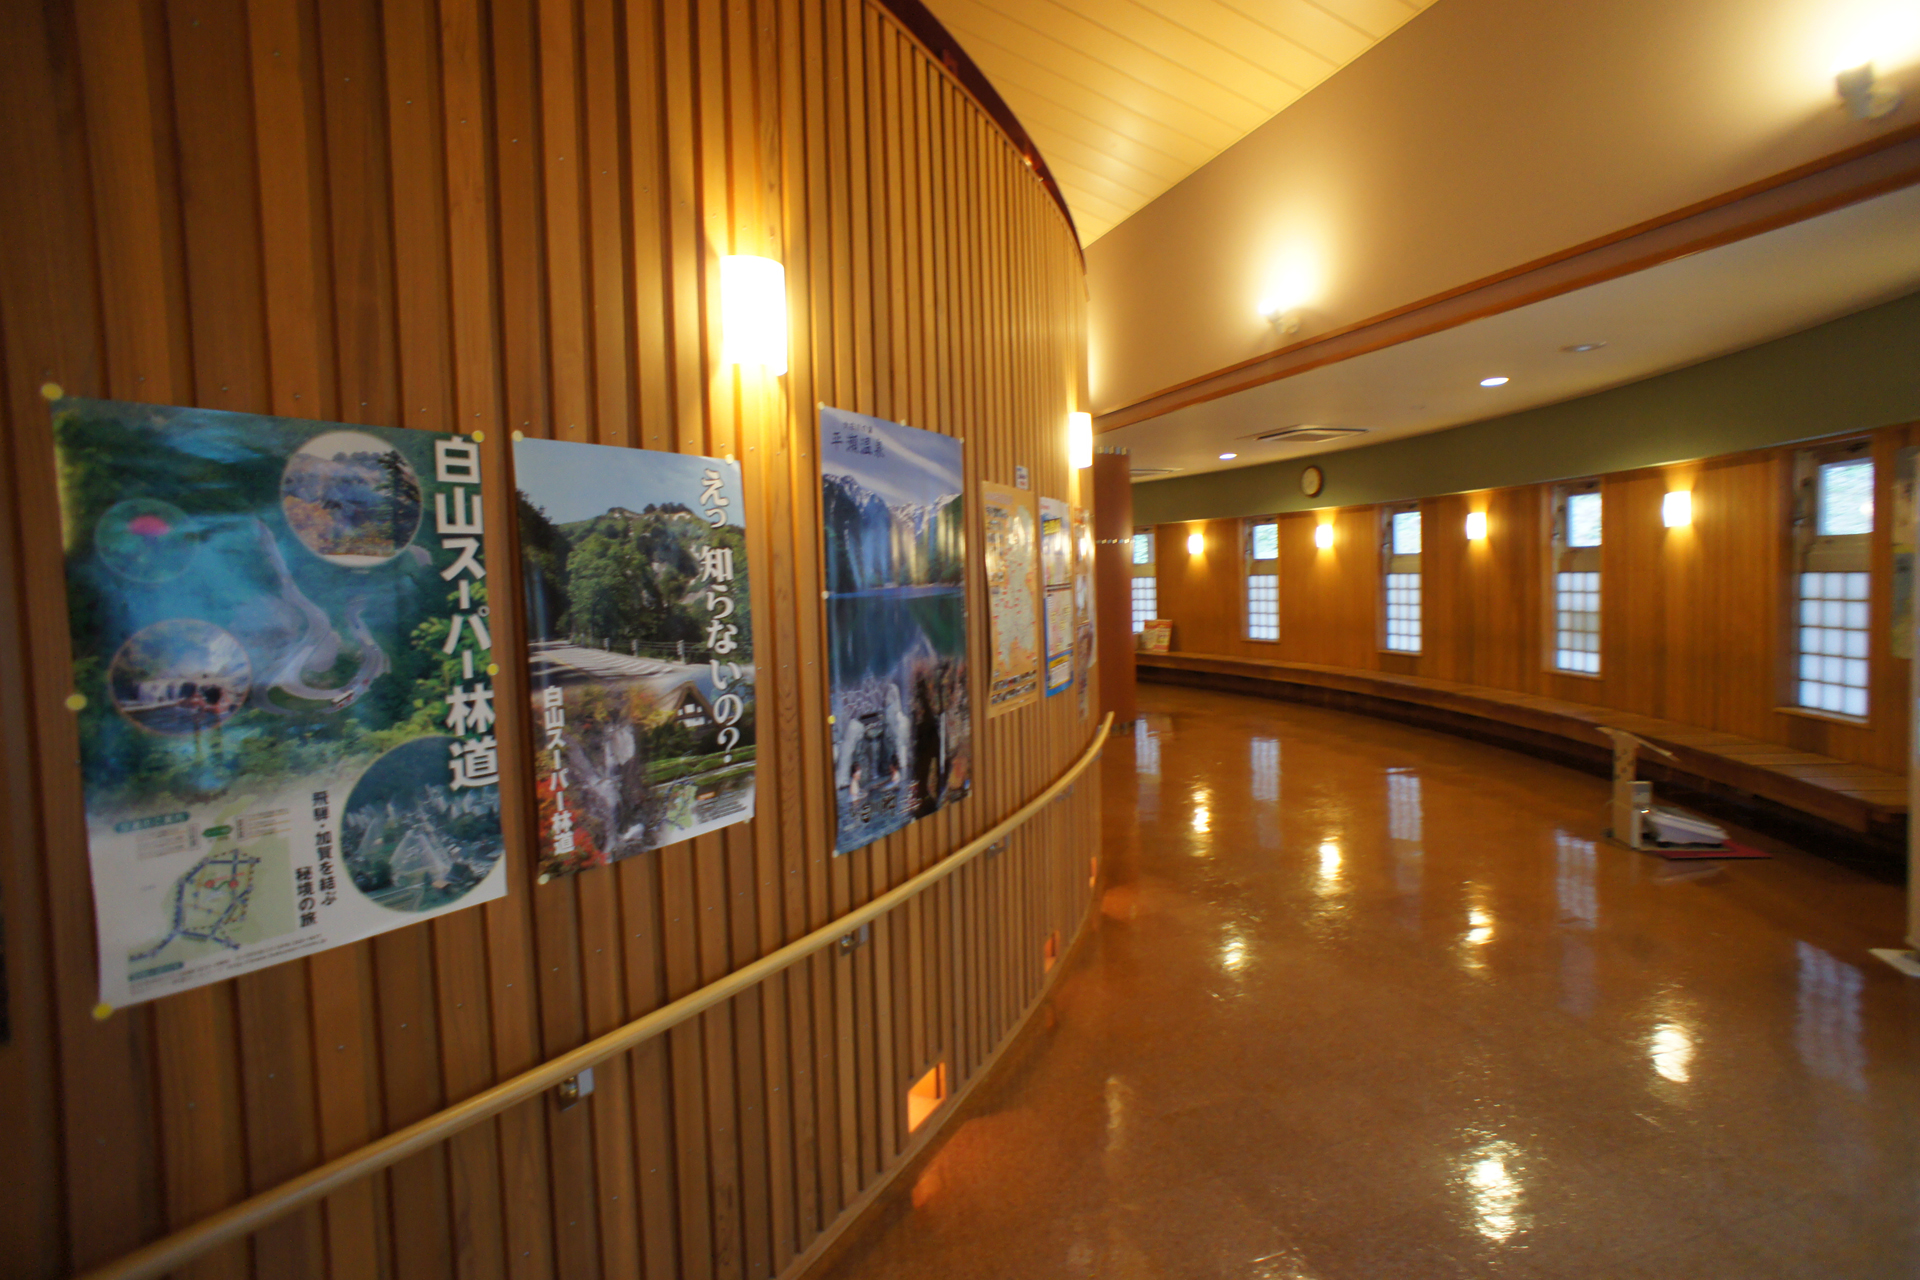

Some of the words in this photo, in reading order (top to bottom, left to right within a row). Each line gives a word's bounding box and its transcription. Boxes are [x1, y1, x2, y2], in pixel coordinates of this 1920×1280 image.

[700, 469, 729, 528] えっ
[435, 436, 499, 791] 白山スーパー林道
[543, 685, 576, 856] 白山スーパー林道
